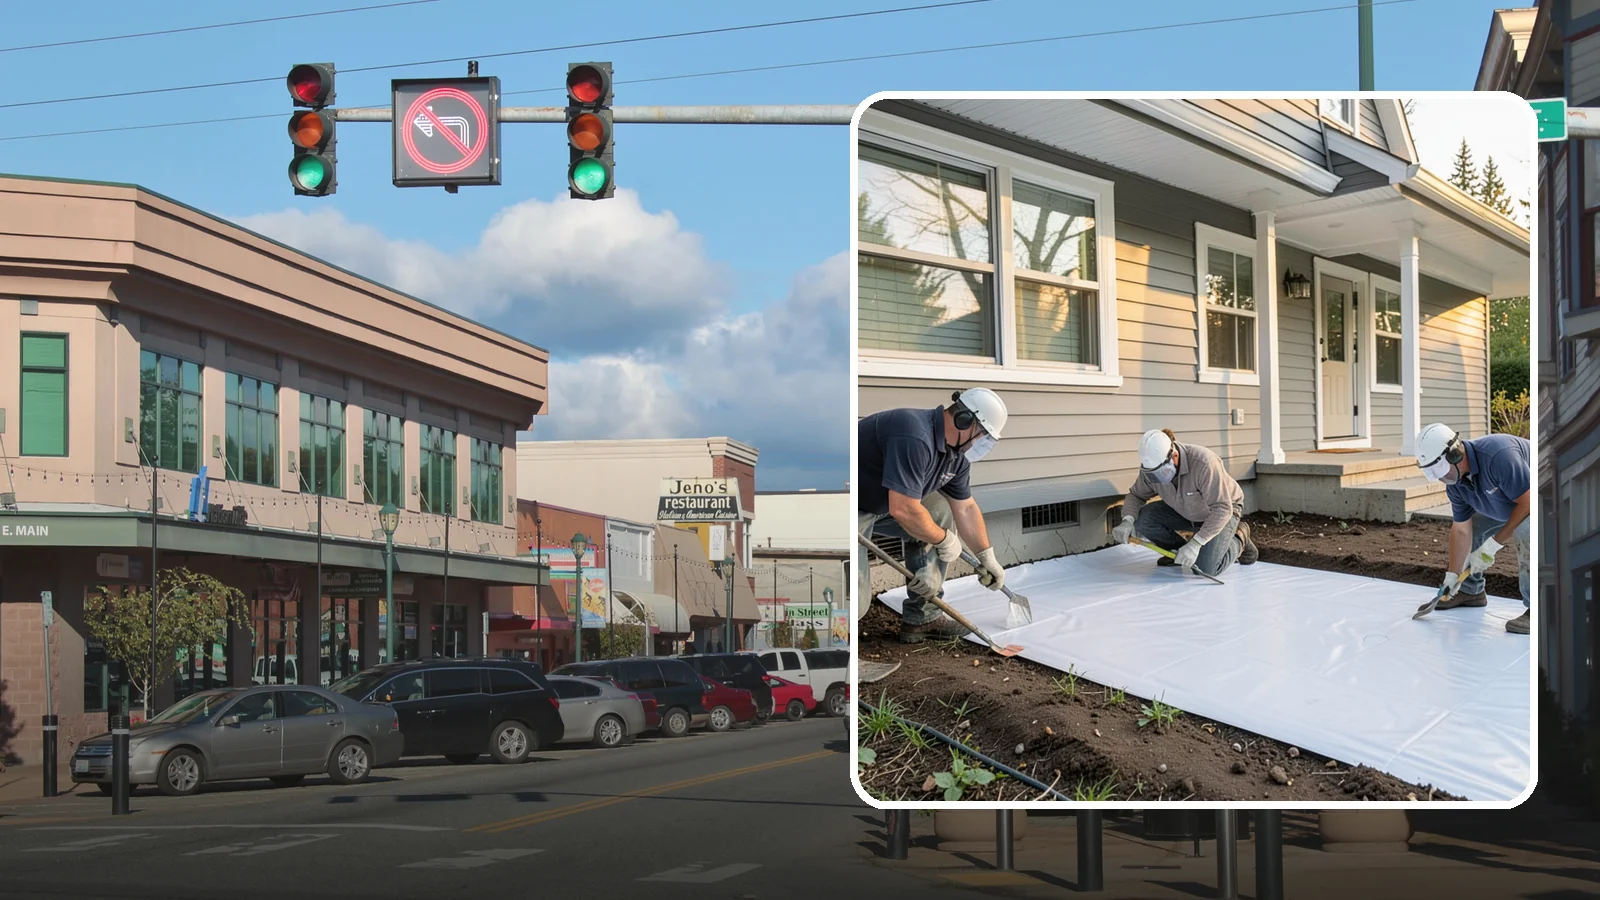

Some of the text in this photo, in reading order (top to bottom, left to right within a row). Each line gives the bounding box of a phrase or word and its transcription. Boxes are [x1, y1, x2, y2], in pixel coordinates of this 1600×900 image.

[670, 480, 727, 494] Jeno's
[665, 496, 731, 509] restaurant
[686, 510, 714, 519] American
[715, 509, 737, 519] Cuisine
[2, 525, 49, 536] E. MAIN
[797, 607, 828, 617] Street
